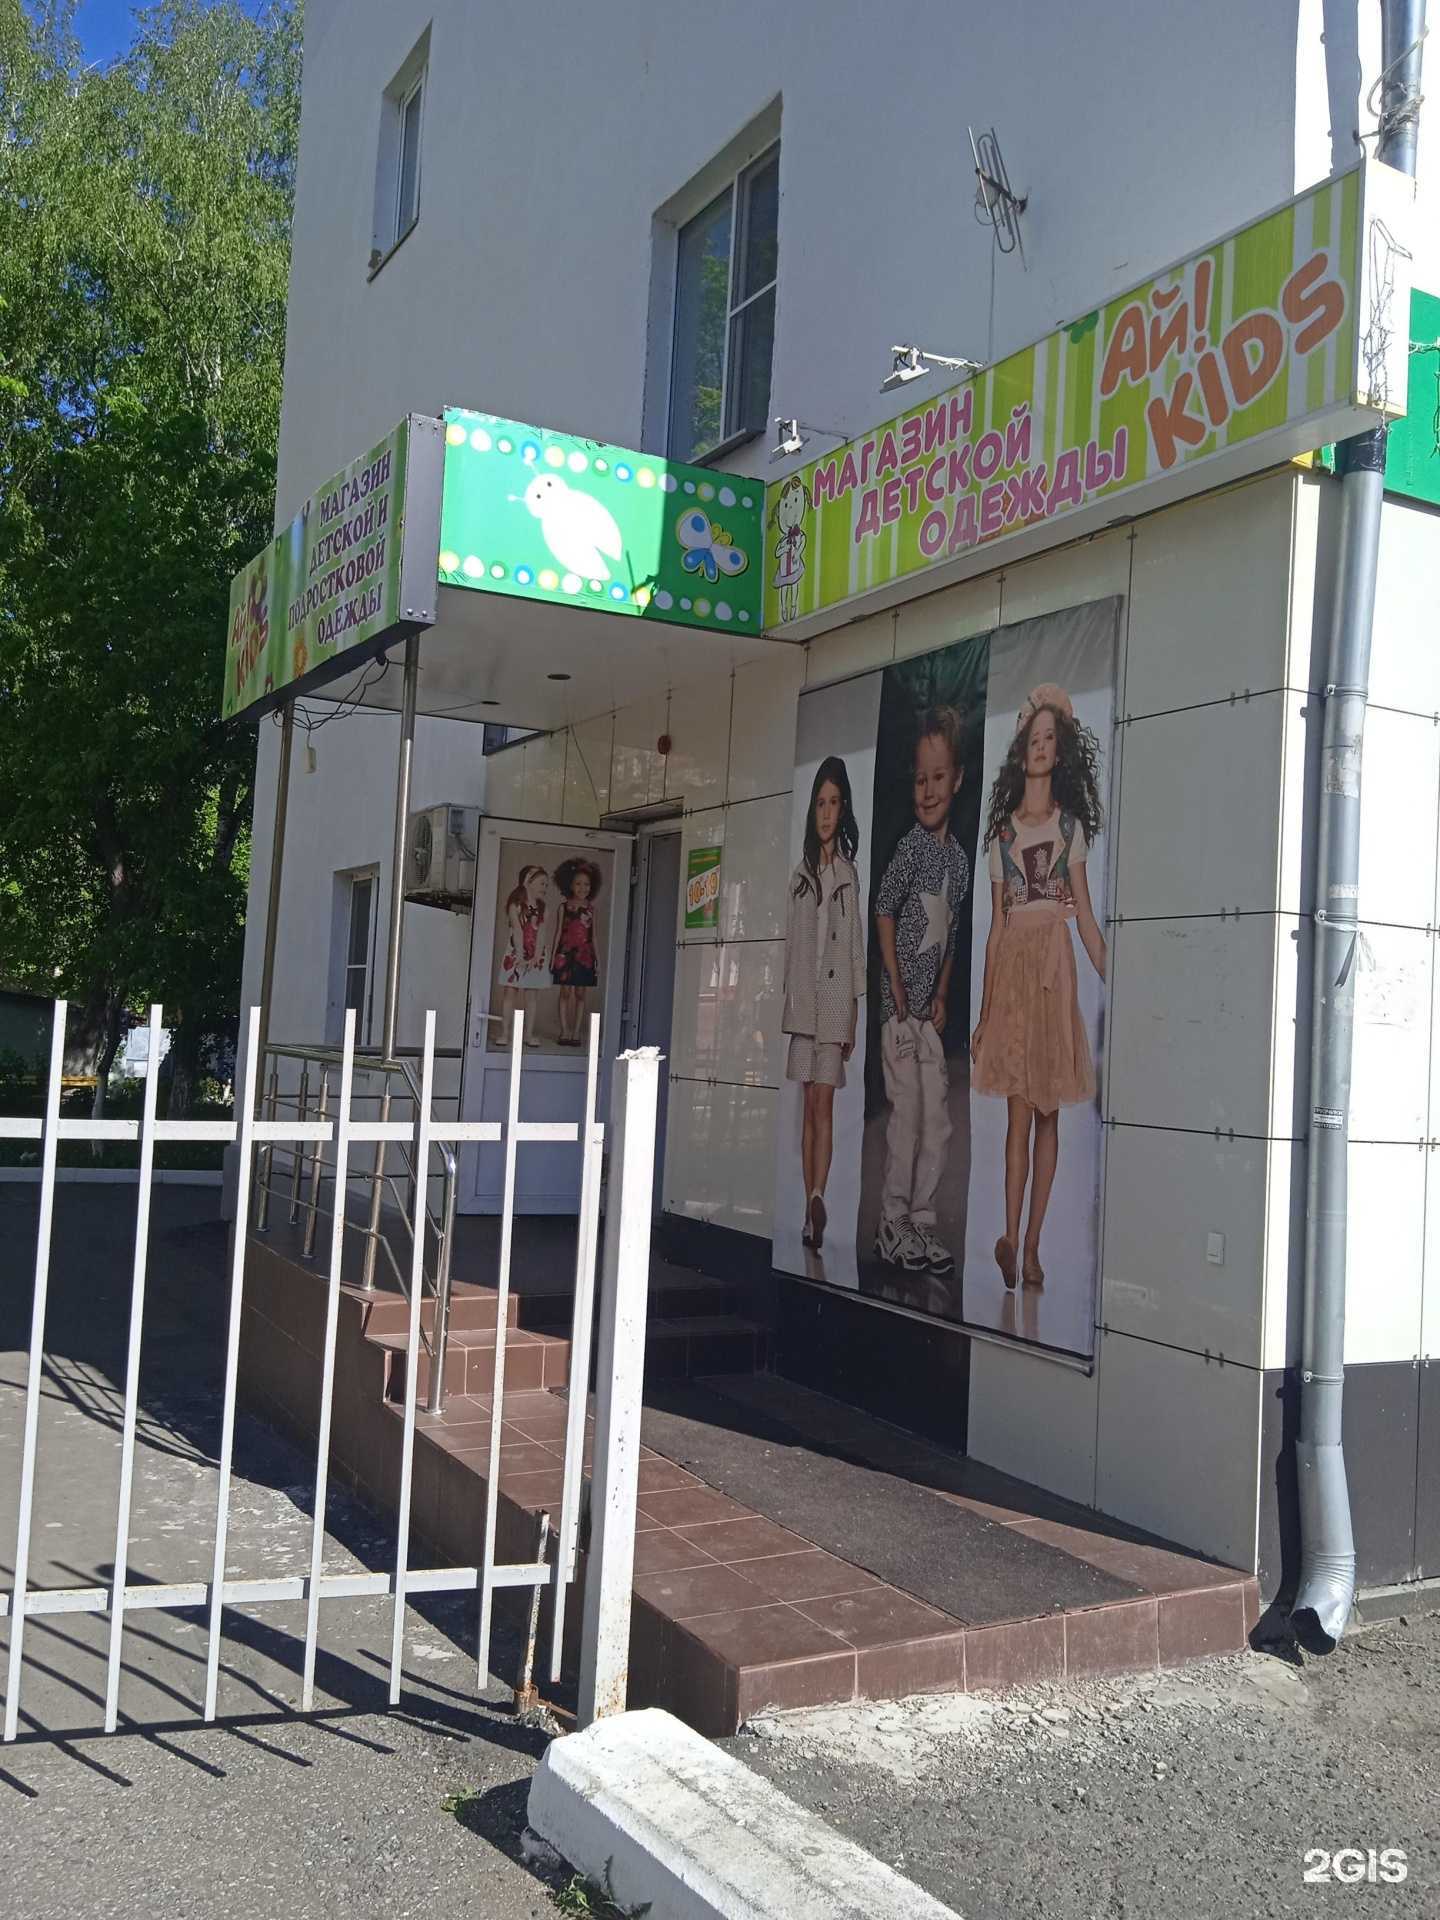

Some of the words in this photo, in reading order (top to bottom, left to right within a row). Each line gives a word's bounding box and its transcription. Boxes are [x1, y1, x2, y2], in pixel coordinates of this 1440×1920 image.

[1148, 252, 1345, 469] KIDS
[319, 449, 392, 528] МАГАЗИН
[812, 391, 972, 508] МАГАЗИН
[854, 402, 1031, 543] ДЕТСКОЙ
[919, 426, 1127, 557] ОДЕЖДЫ
[288, 533, 386, 632] ПОДРОСТКОВОЙ
[309, 501, 375, 577] ДЕТСКОЙ
[377, 494, 389, 528] И
[317, 582, 384, 646] ОДЕЖДЫ
